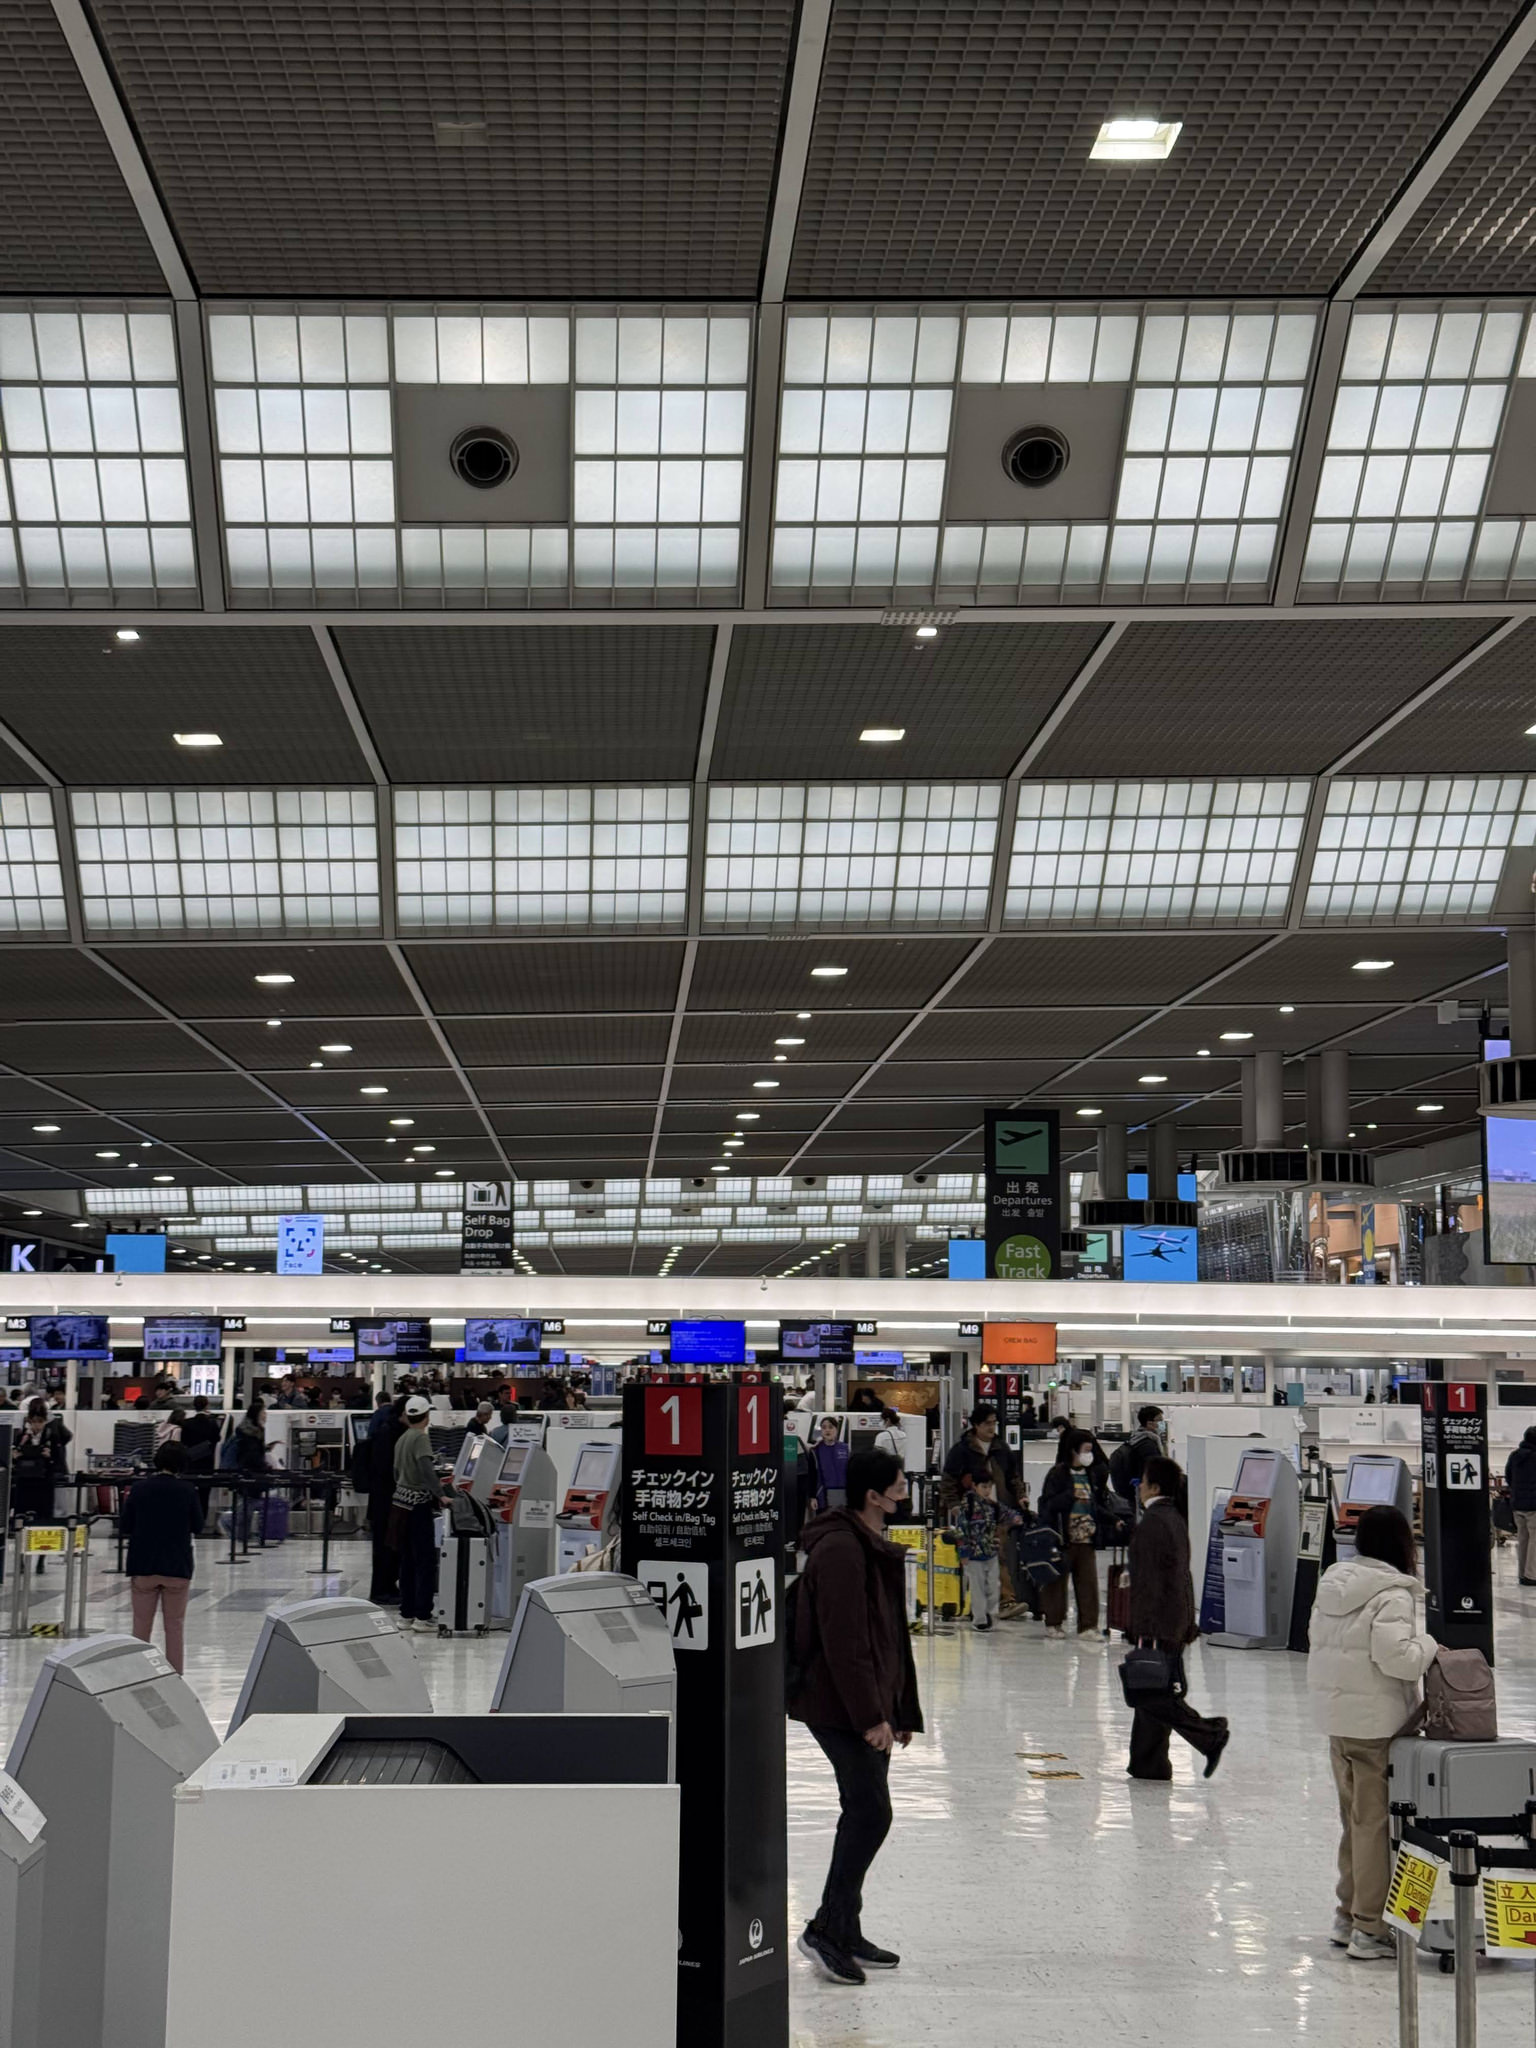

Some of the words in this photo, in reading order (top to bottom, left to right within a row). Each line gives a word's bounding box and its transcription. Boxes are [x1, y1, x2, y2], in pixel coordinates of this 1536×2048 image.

[993, 1195, 1053, 1206] Departures
[464, 1215, 486, 1225] Self
[489, 1215, 510, 1227] Bag
[464, 1227, 494, 1239] Drop
[11, 1244, 36, 1272] K
[1005, 1243, 1041, 1258] Fast
[998, 1263, 1046, 1279] Track
[7, 1318, 27, 1329] M3
[224, 1318, 243, 1329] M4
[332, 1320, 351, 1330] M5
[544, 1321, 562, 1331] M6
[649, 1322, 667, 1333] M7
[857, 1322, 874, 1333] M8
[961, 1324, 979, 1334] M9
[983, 1377, 993, 1393] 2
[1009, 1377, 1017, 1393] 2
[1425, 1387, 1432, 1408] 1
[1455, 1387, 1466, 1409] 1
[660, 1395, 680, 1446] 1
[746, 1394, 758, 1445] 1
[631, 1469, 715, 1488] チェックイン
[732, 1468, 778, 1488] チェックイン
[635, 1489, 711, 1509] 手荷物タグ
[734, 1487, 776, 1510] 手荷物タグ
[632, 1511, 648, 1521] Self
[649, 1512, 673, 1522] Check
[674, 1512, 700, 1526] in/Bag
[701, 1513, 716, 1526] Tag
[1500, 1884, 1535, 1900] 立入
